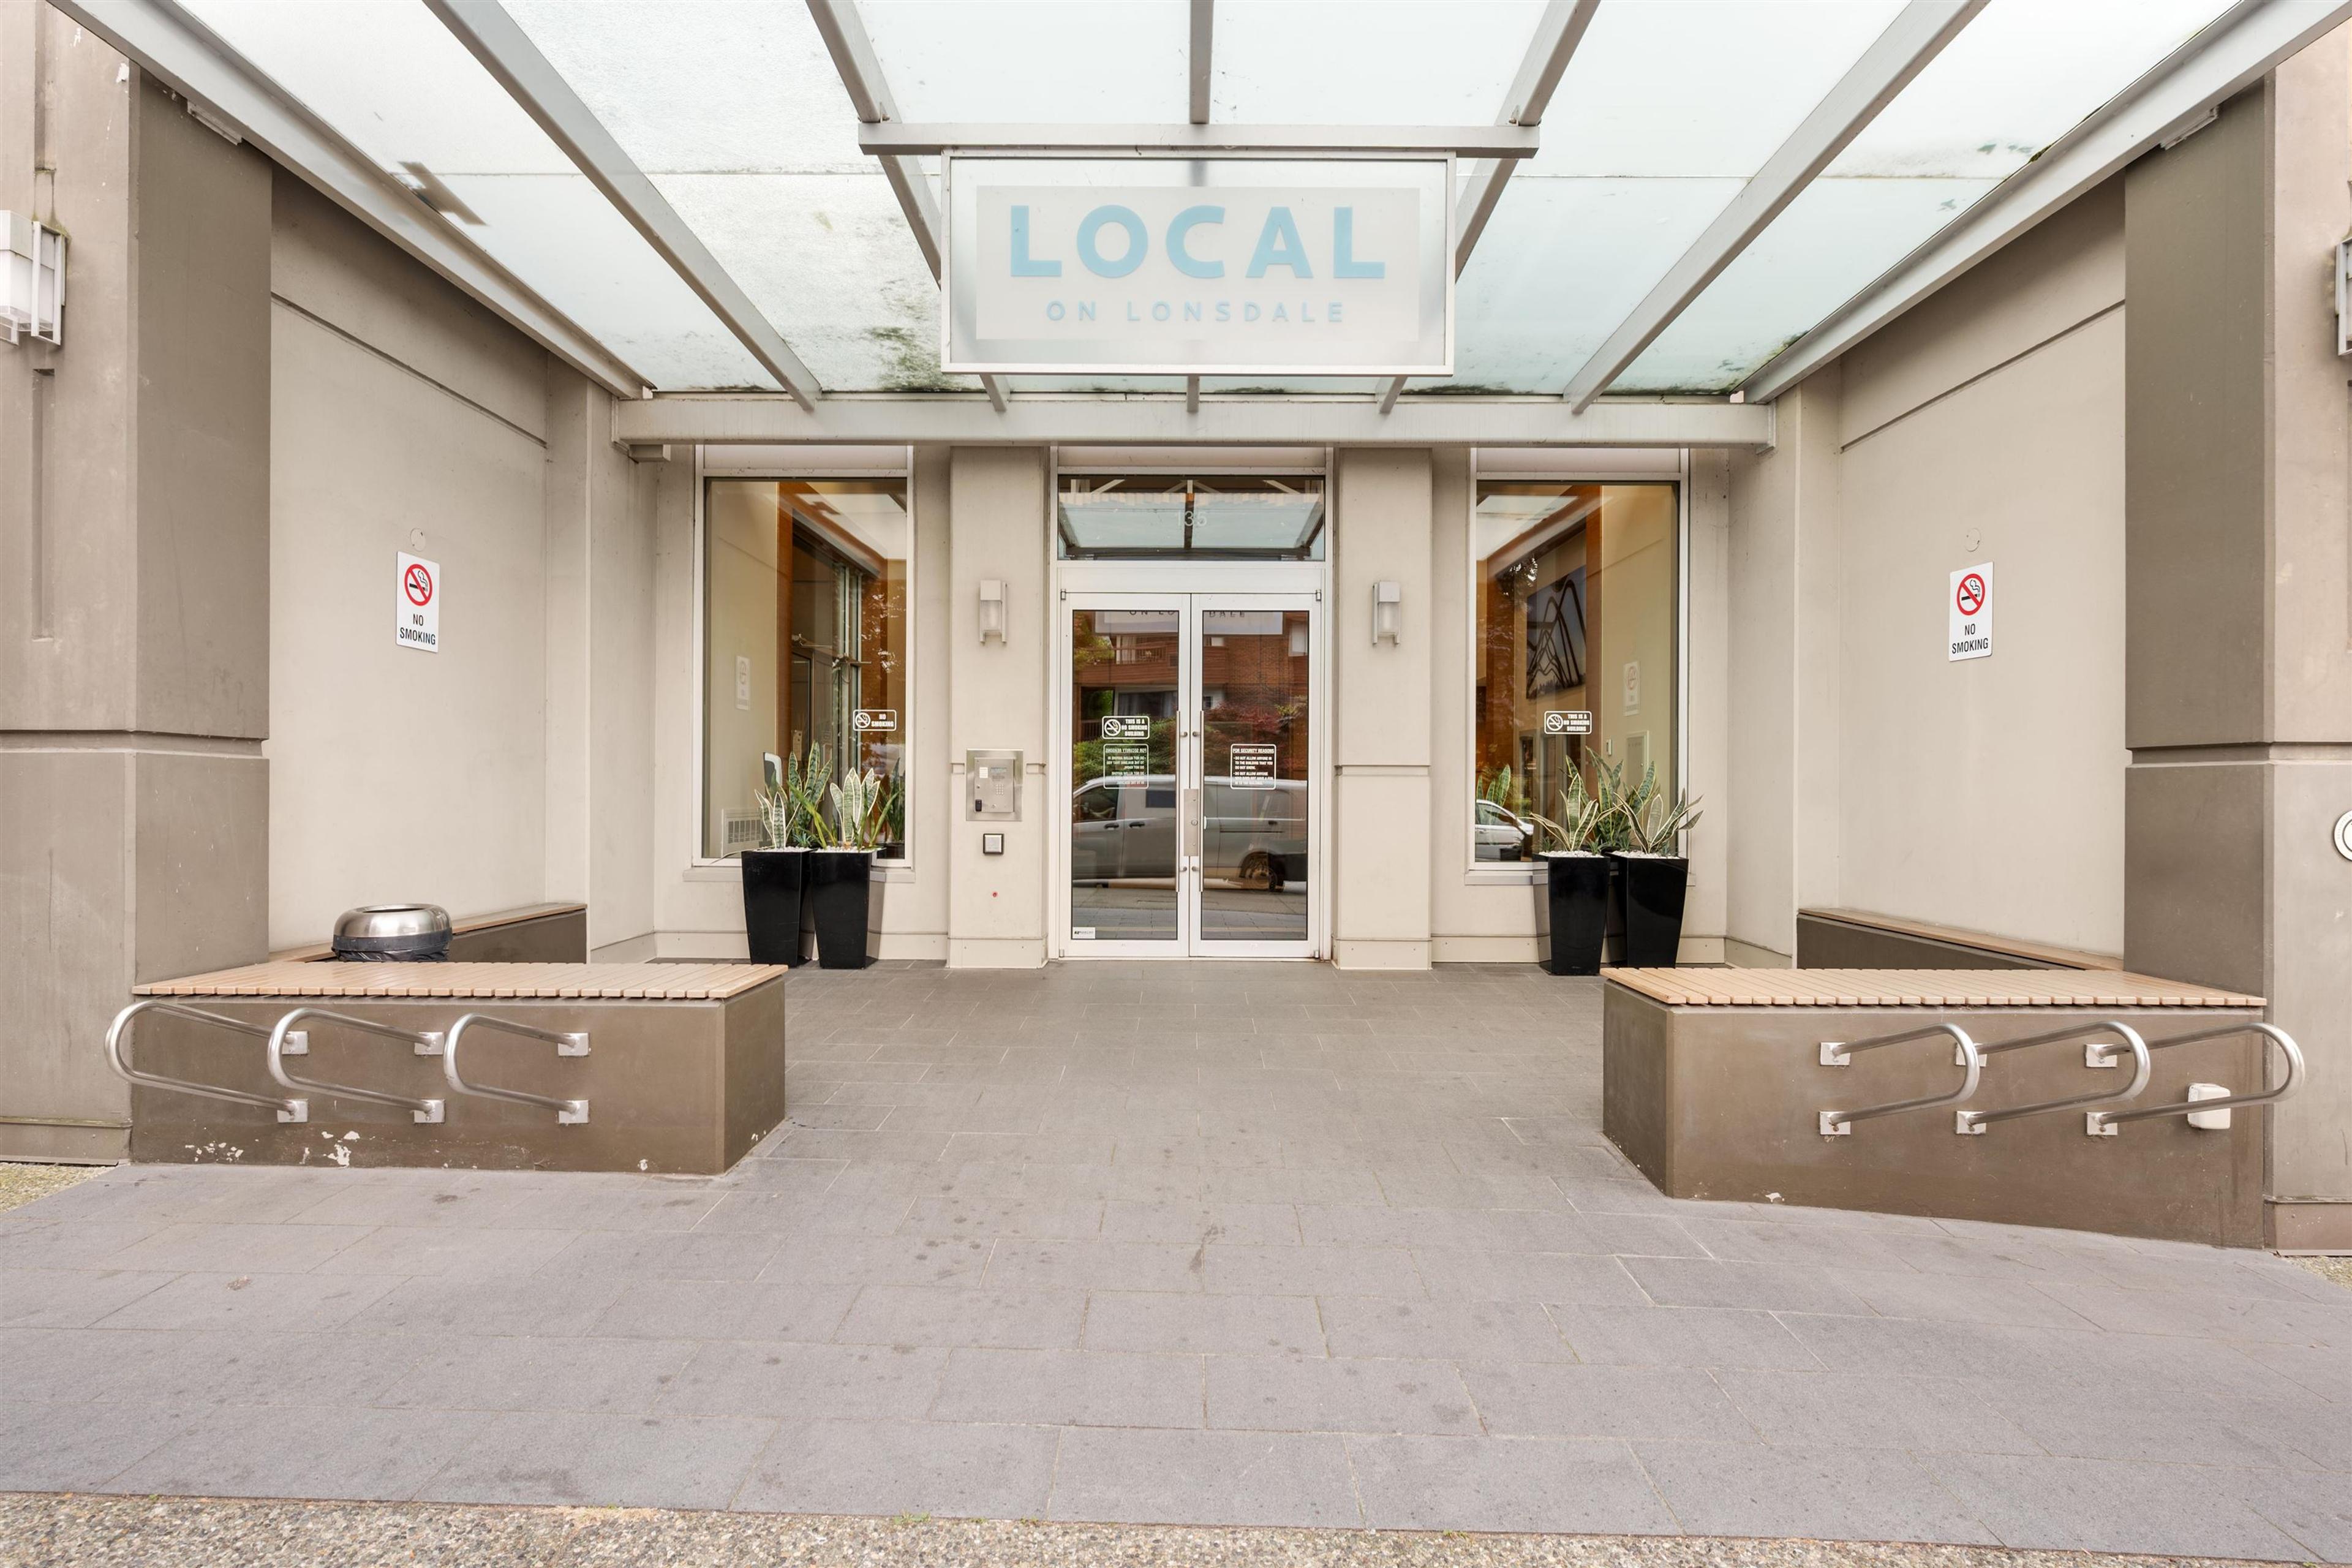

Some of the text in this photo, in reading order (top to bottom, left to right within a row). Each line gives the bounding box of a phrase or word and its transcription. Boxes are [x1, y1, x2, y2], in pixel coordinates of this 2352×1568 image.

[1010, 204, 1385, 279] LOCAL
[1046, 300, 1344, 323] ON LONSDALE
[1177, 510, 1207, 526] 135
[413, 613, 424, 626] NO
[400, 627, 435, 645] SMOKING
[1964, 623, 1975, 636] NO
[1952, 638, 1989, 654] SMOKING
